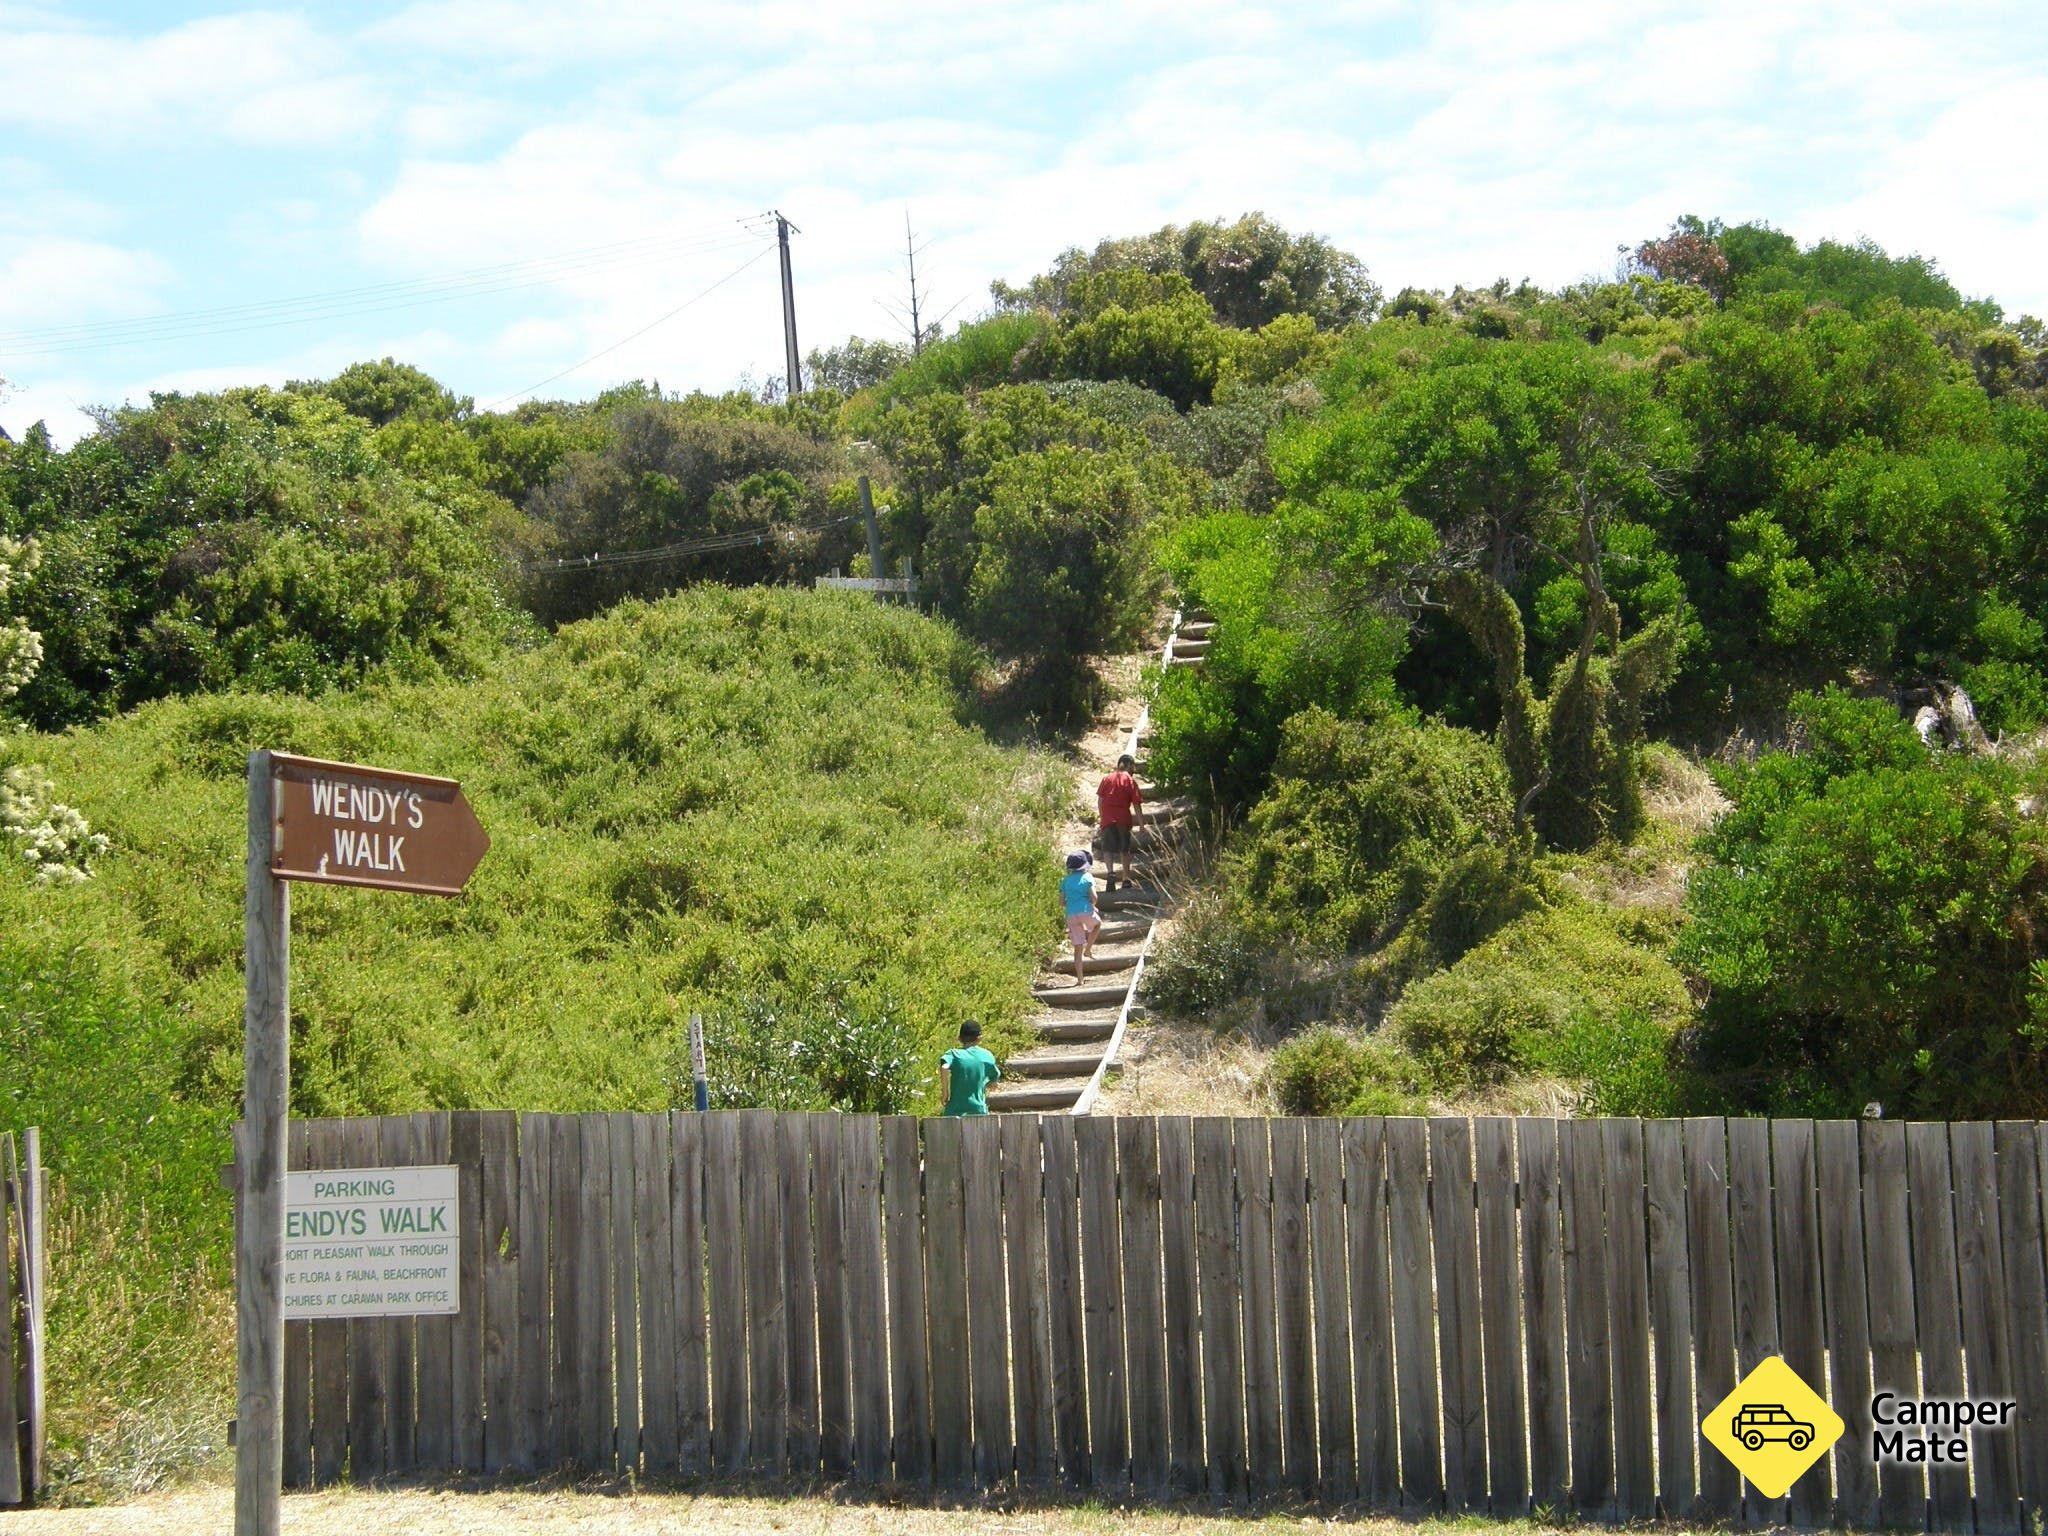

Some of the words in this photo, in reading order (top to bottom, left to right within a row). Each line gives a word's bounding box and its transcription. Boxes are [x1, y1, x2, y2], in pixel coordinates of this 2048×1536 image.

[312, 778, 423, 829] WENDY'S
[334, 828, 406, 872] WALK
[314, 1179, 395, 1198] PARKING
[286, 1208, 367, 1237] ENDYS
[379, 1206, 447, 1234] WALK
[313, 1247, 364, 1260] PLEASANT
[367, 1245, 395, 1257] WALK
[400, 1244, 449, 1256] THROUGH
[285, 1273, 296, 1284] VE
[300, 1272, 330, 1283] FLORA
[335, 1271, 342, 1282] &
[383, 1267, 448, 1280] BEACHFRONT
[285, 1294, 322, 1307] CHURES
[326, 1294, 337, 1305] AT
[341, 1292, 383, 1304] CARAVAN
[387, 1292, 411, 1304] PARK
[415, 1290, 449, 1303] OFFICE
